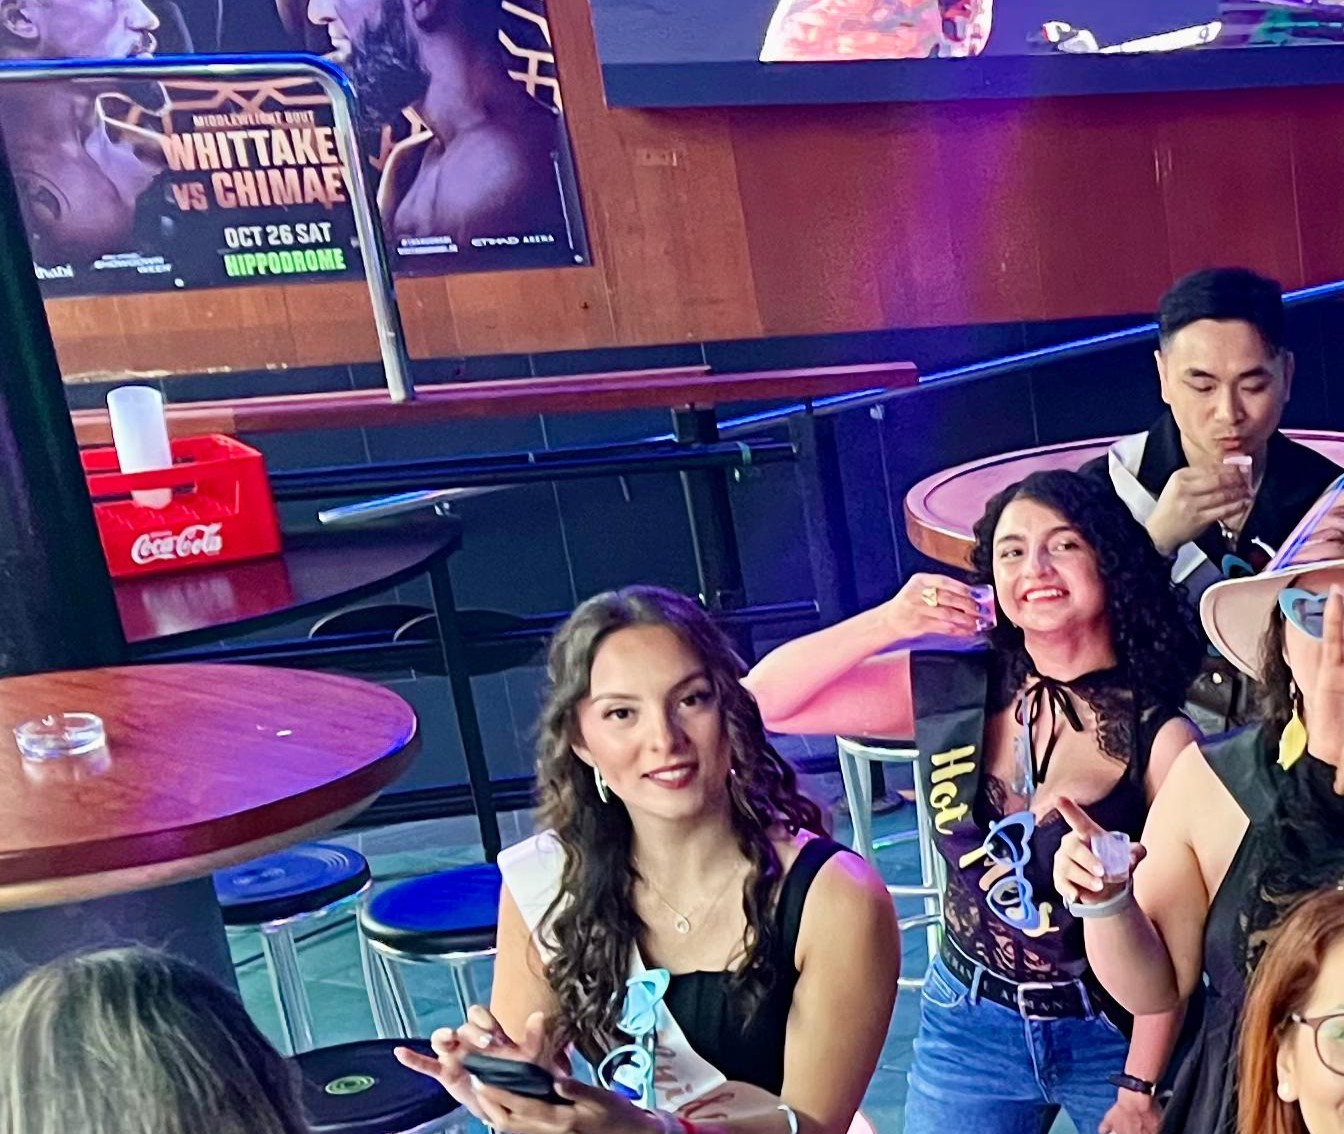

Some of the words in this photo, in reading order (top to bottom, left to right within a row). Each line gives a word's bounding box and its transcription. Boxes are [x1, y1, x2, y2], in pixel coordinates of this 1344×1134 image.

[162, 127, 344, 171] WHITTAKE
[171, 181, 209, 211] VS
[211, 166, 347, 209] CHIMAE
[224, 226, 263, 248] OCT
[265, 224, 294, 246] 26
[295, 222, 332, 244] SAT
[223, 248, 347, 277] HIPPODROME
[131, 522, 223, 565] Coca-Cola
